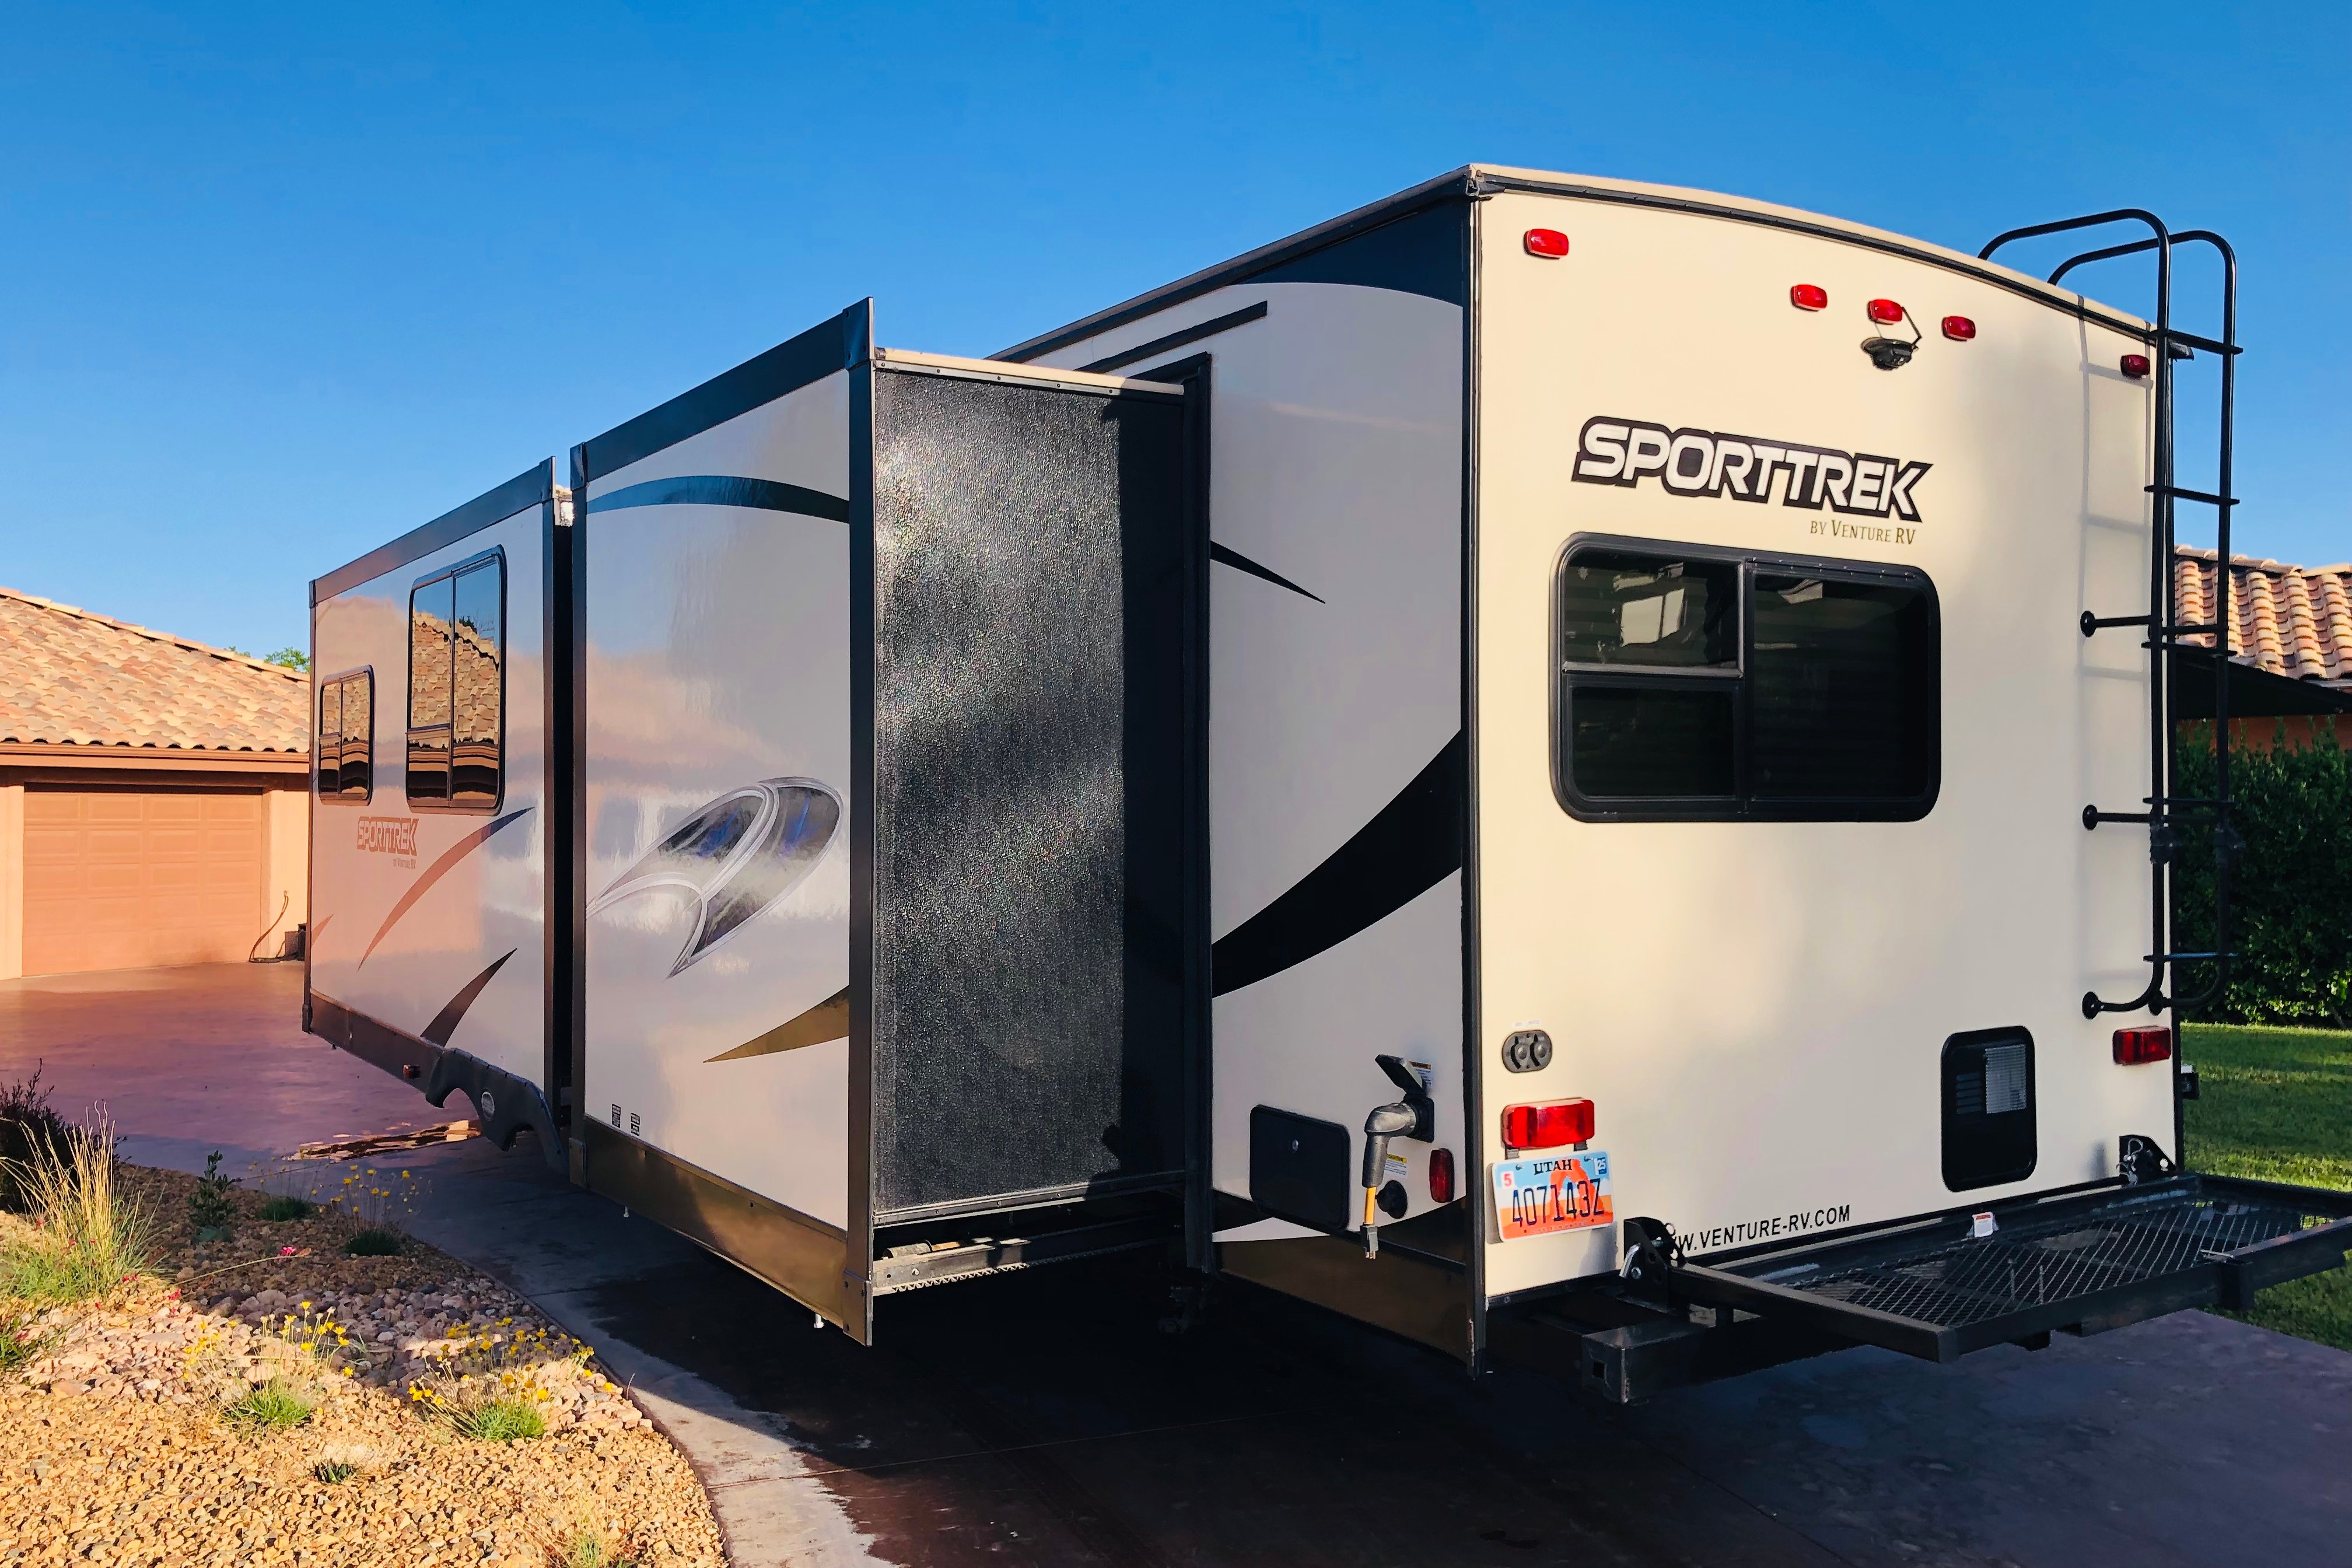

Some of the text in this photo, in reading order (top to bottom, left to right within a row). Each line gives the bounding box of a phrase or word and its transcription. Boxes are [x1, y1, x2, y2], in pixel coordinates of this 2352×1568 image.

[1571, 416, 1934, 523] SPORTTREK
[1810, 521, 1828, 535] BY
[1895, 527, 1916, 545] RV
[357, 816, 419, 856] SPORTTREK
[1503, 1173, 1512, 1186] 5
[1533, 1158, 1572, 1175] UTAH
[1673, 1204, 1851, 1252] W.VENTURE-RV.COM
